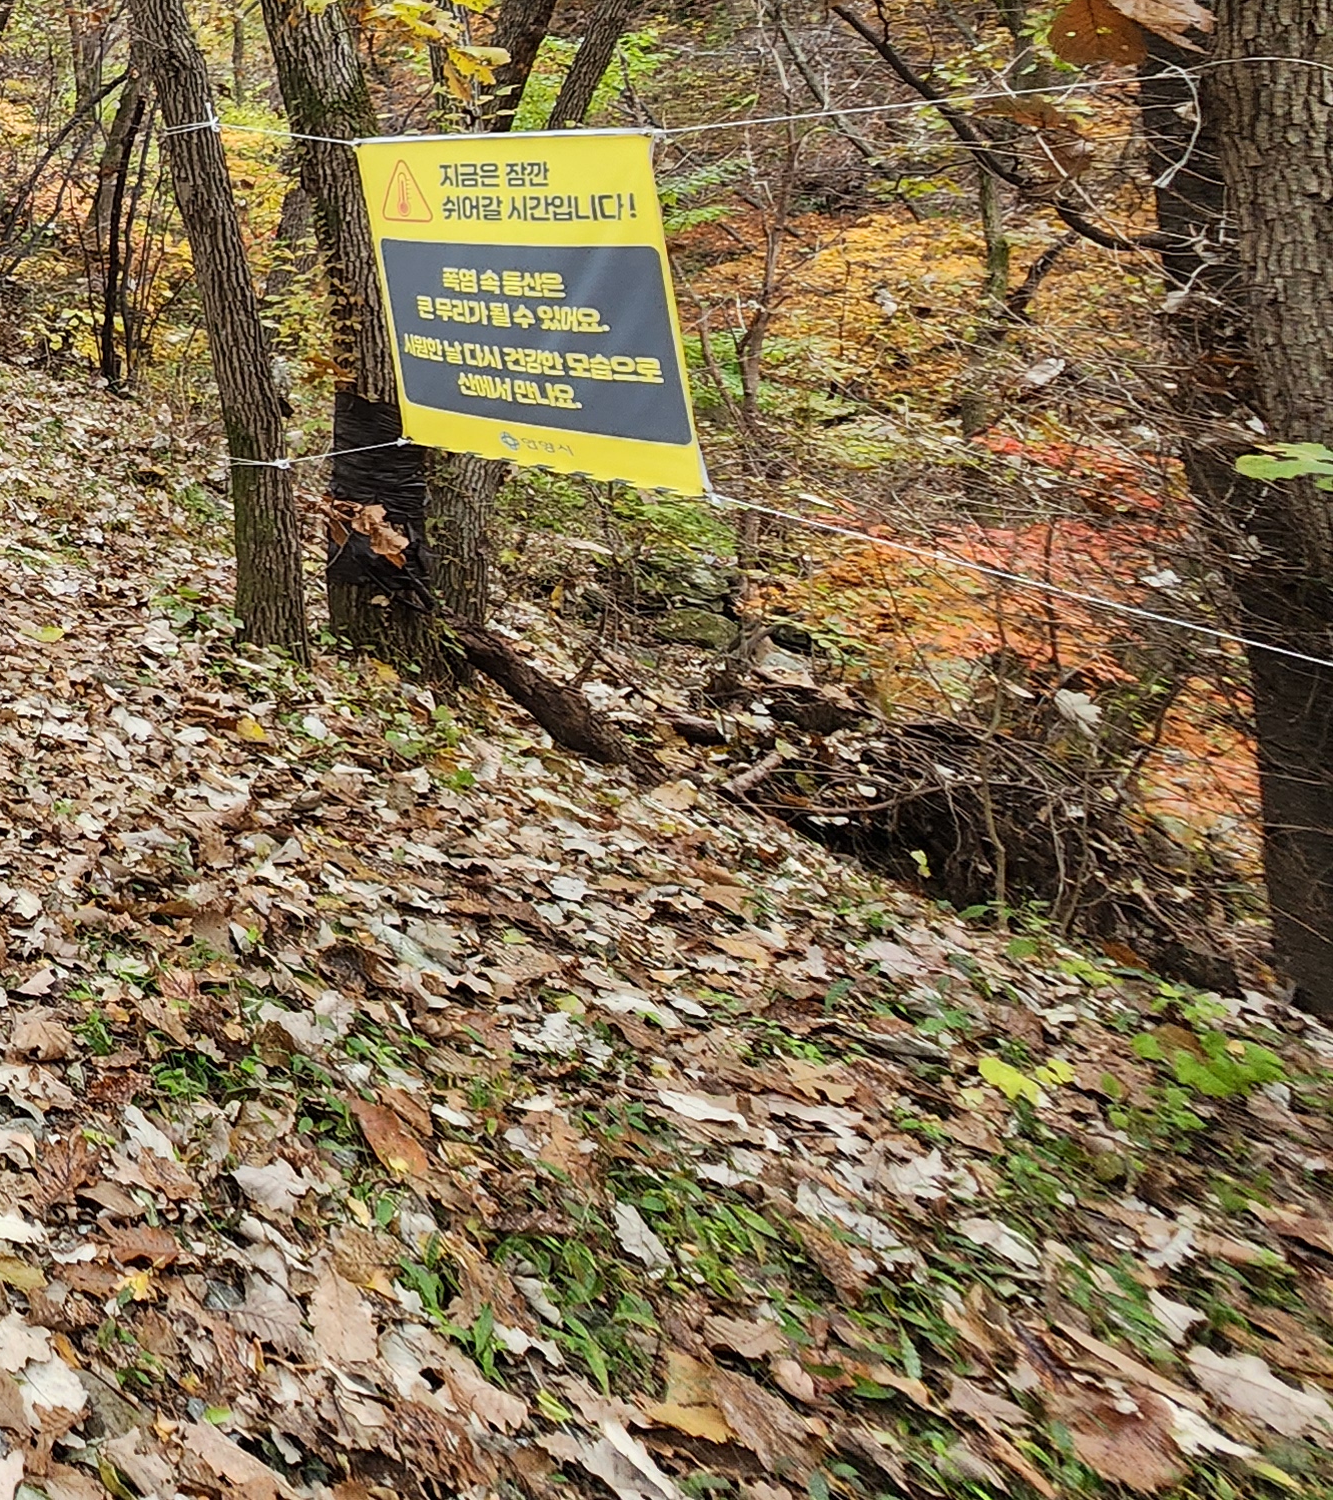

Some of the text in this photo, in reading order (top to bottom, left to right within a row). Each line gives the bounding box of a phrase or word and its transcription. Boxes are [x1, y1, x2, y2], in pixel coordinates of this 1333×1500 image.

[439, 161, 550, 188] 지금은 잠깐
[442, 195, 503, 221] 쉬어갈
[442, 266, 566, 299] 폭염 속 등산은
[416, 295, 611, 333] 큰 무리가 될 수 있어요.
[403, 332, 665, 384] 시원한 날 다시 건강한 모습으로
[457, 371, 583, 410] 산에서 만나요.
[521, 437, 575, 457] 안양시
